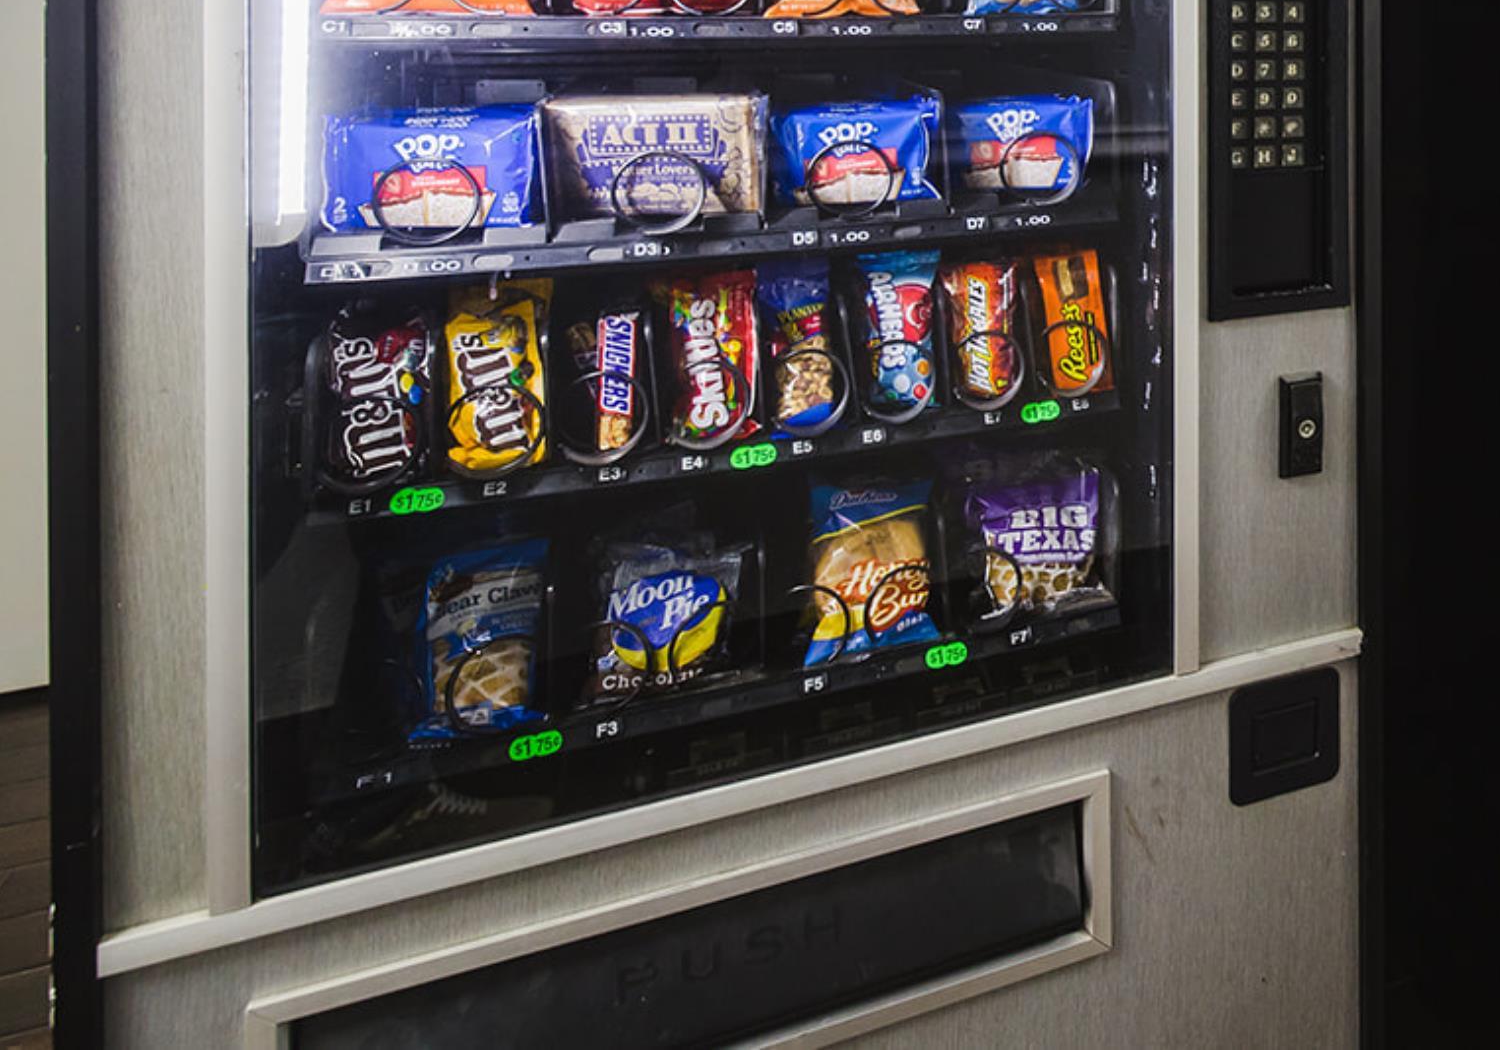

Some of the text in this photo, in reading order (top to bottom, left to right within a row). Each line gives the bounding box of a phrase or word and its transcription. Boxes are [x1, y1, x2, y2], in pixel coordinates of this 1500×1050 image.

[600, 22, 674, 37] C3 1.00
[773, 22, 871, 35] C5 1.00
[1022, 22, 1058, 31] 1.00
[602, 122, 699, 146] ACT II
[966, 215, 1050, 230] D7 1.00
[793, 230, 869, 246] D5 1.00
[634, 244, 656, 256] D3
[603, 315, 635, 413] SNICKERS
[863, 429, 882, 443] E6
[793, 440, 813, 455] E5
[682, 456, 703, 470] E4
[600, 468, 621, 482] E3
[484, 481, 507, 496] E2
[351, 499, 371, 513] E1
[1011, 505, 1089, 529] BIG
[998, 529, 1096, 554] TEXAS
[607, 575, 694, 622] Moon
[659, 590, 709, 631] Pie
[1011, 629, 1029, 646] F7
[804, 675, 825, 693] F5
[596, 720, 618, 738] F3
[614, 901, 841, 1008] PUSH
